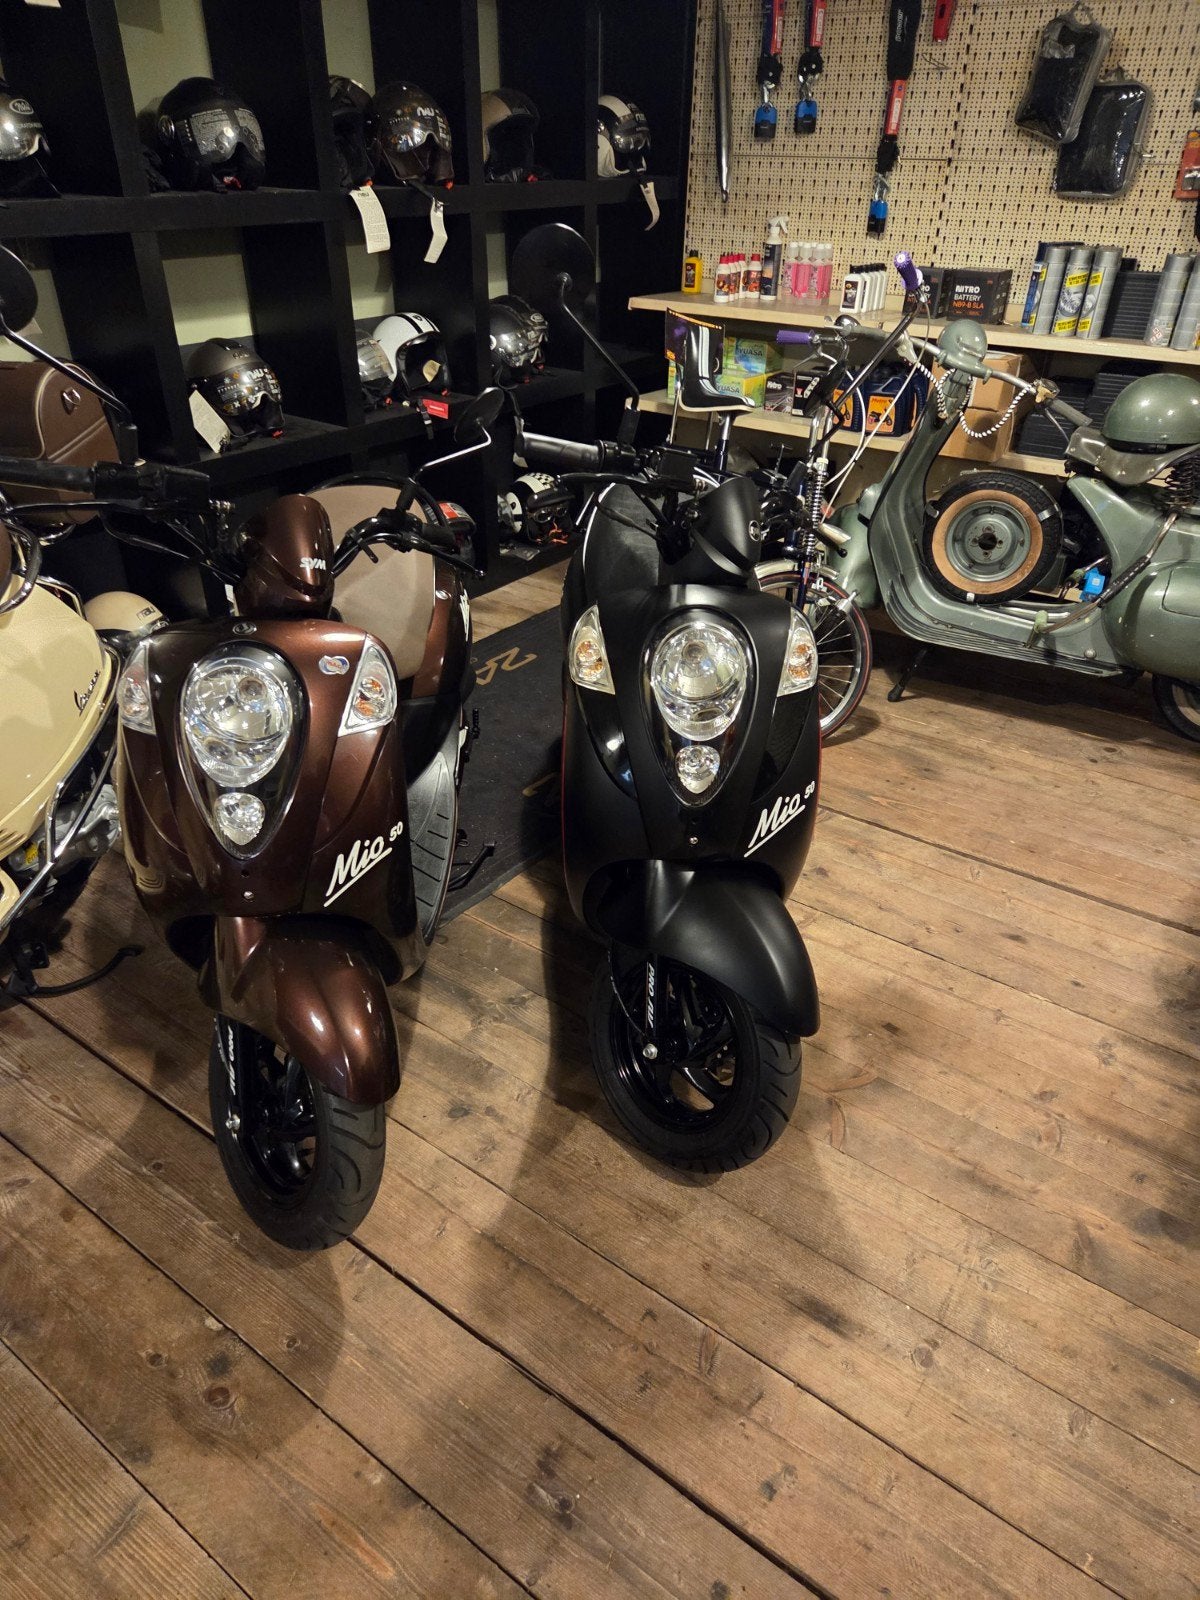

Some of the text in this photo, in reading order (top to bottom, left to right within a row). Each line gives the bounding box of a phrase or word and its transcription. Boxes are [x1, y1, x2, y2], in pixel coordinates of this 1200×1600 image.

[955, 285, 980, 294] NITRO
[954, 294, 981, 302] BATTERY
[741, 346, 763, 357] YUASA
[299, 557, 326, 570] SYM
[746, 781, 816, 853] Mio 50
[325, 821, 404, 902] Mio 50
